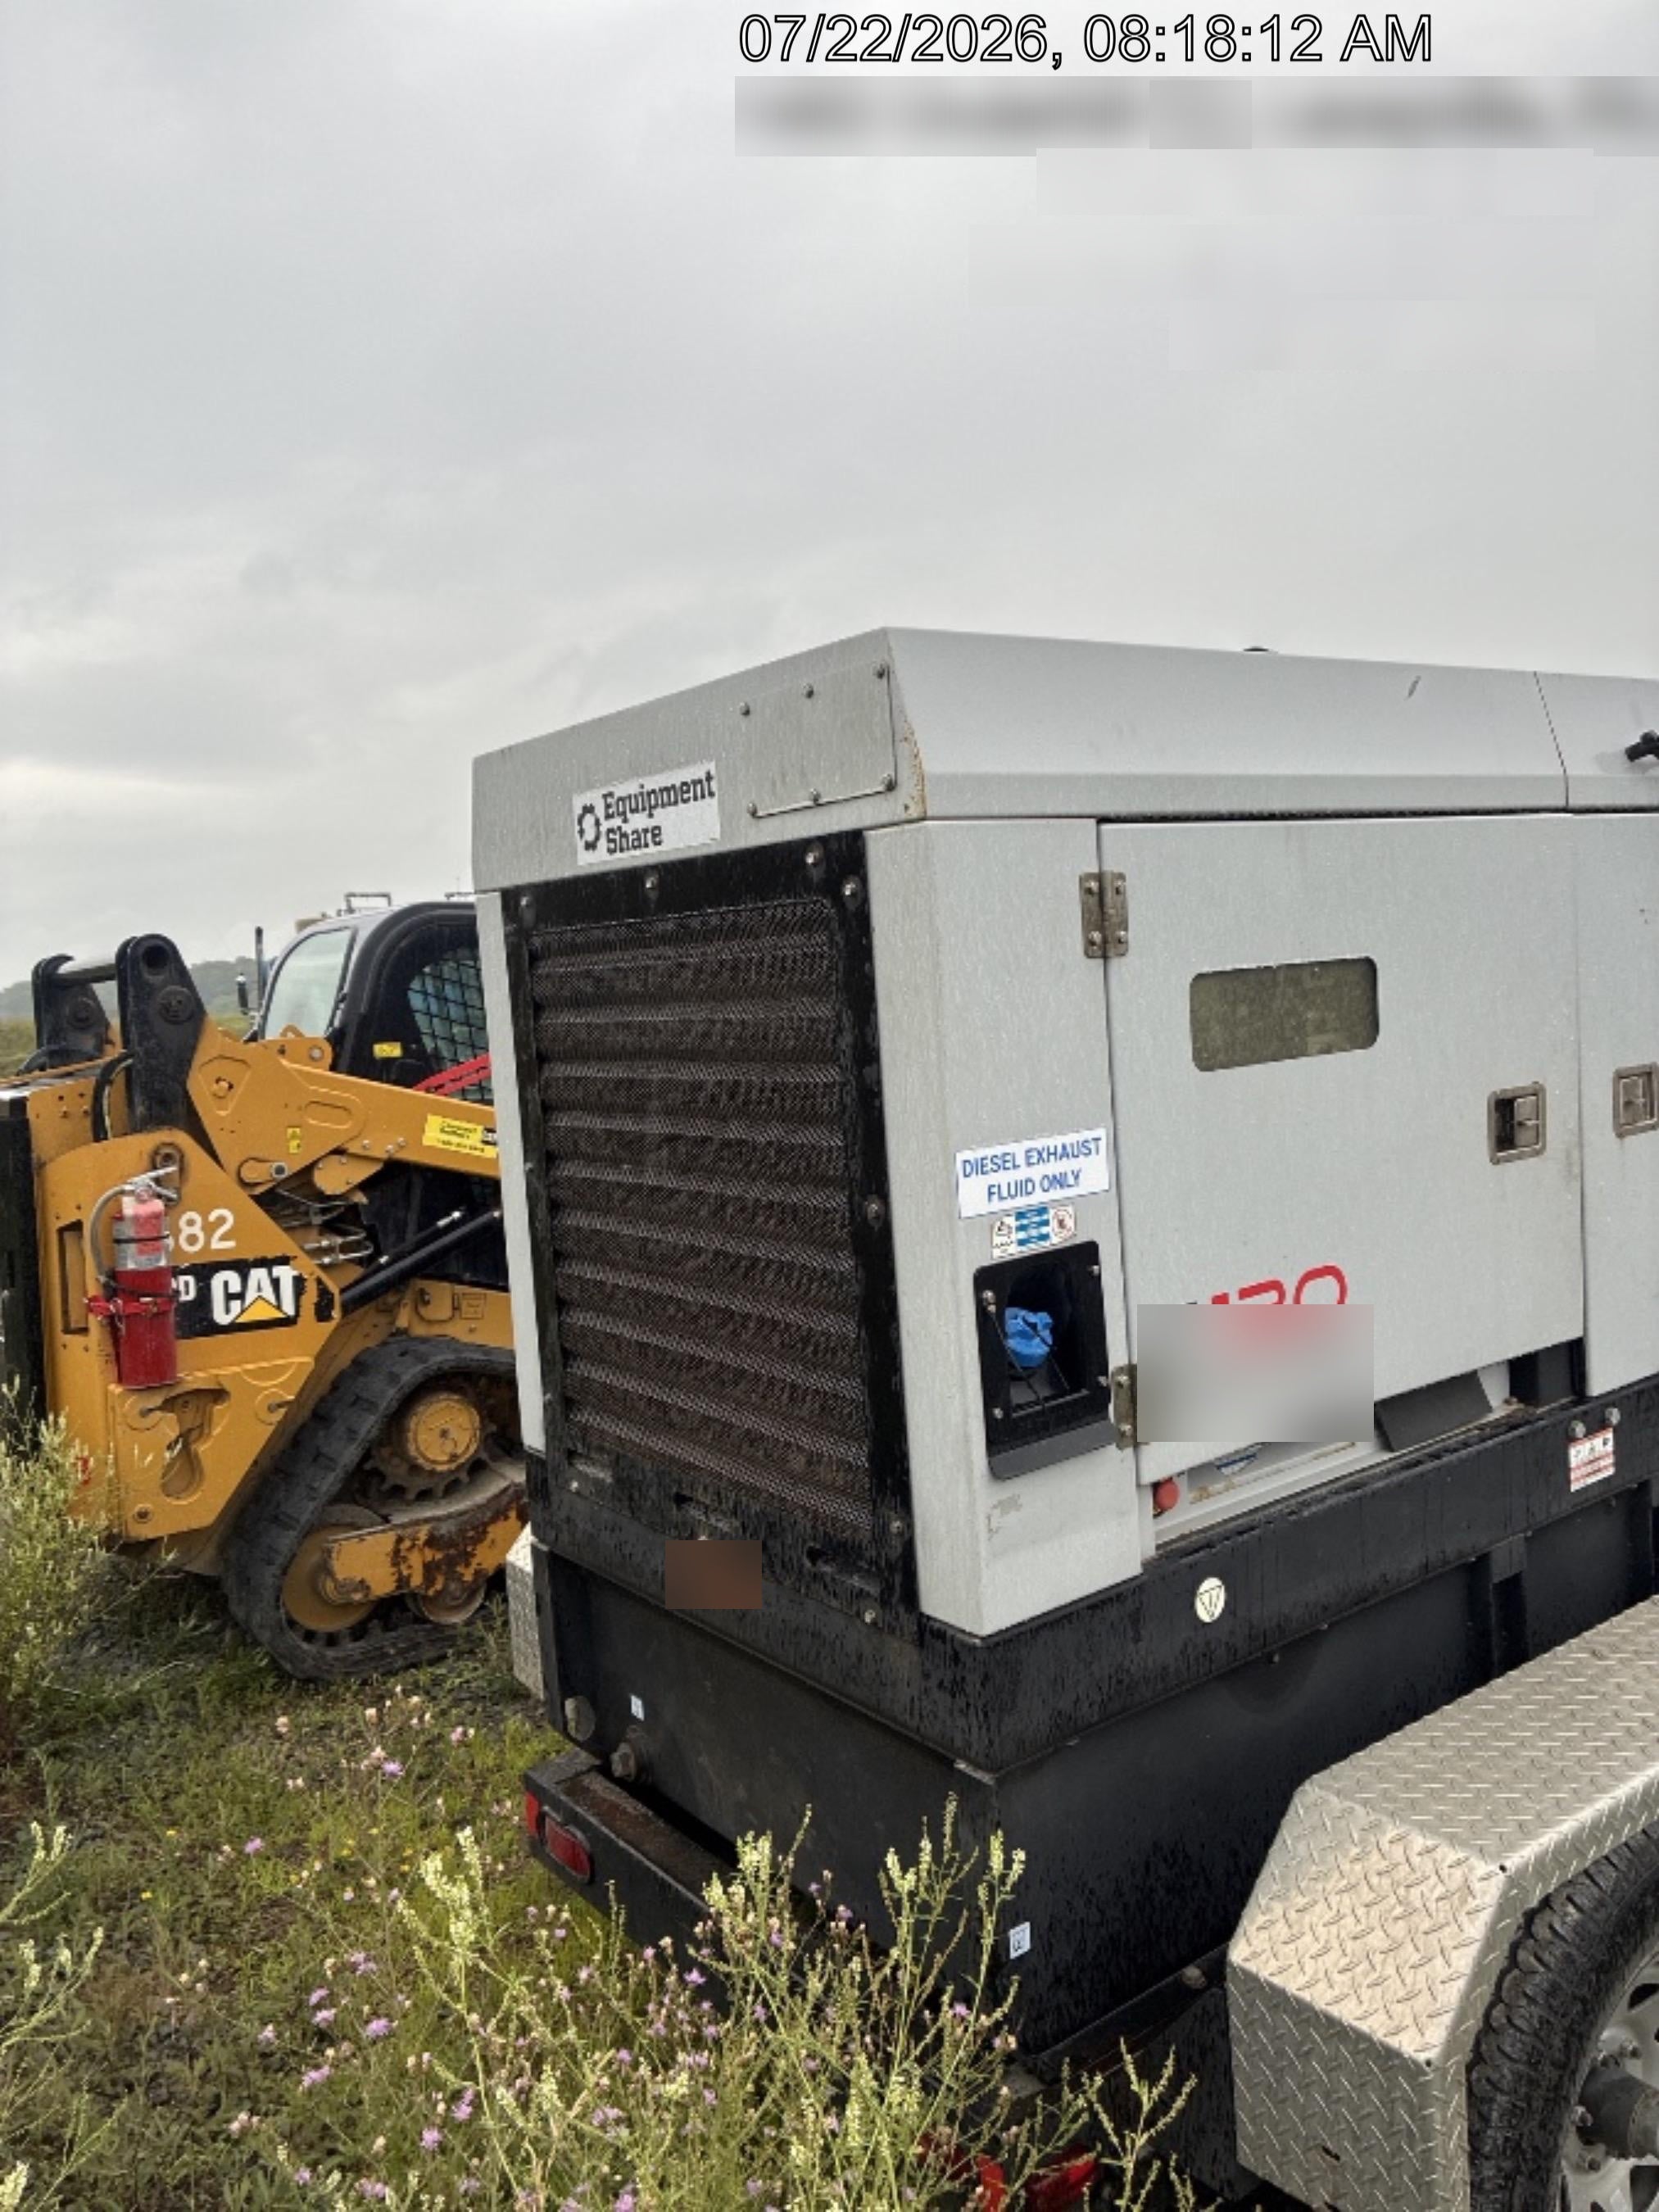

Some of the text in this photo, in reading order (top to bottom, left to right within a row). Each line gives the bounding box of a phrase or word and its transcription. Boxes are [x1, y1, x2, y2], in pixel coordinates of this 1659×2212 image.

[602, 769, 715, 823] Equipment
[605, 824, 664, 855] Share
[962, 1136, 1102, 1178] DIESEL EXHAUST
[987, 1167, 1082, 1204] FLUID ONLY
[165, 1208, 237, 1253] 82
[211, 1265, 300, 1326] CAT
